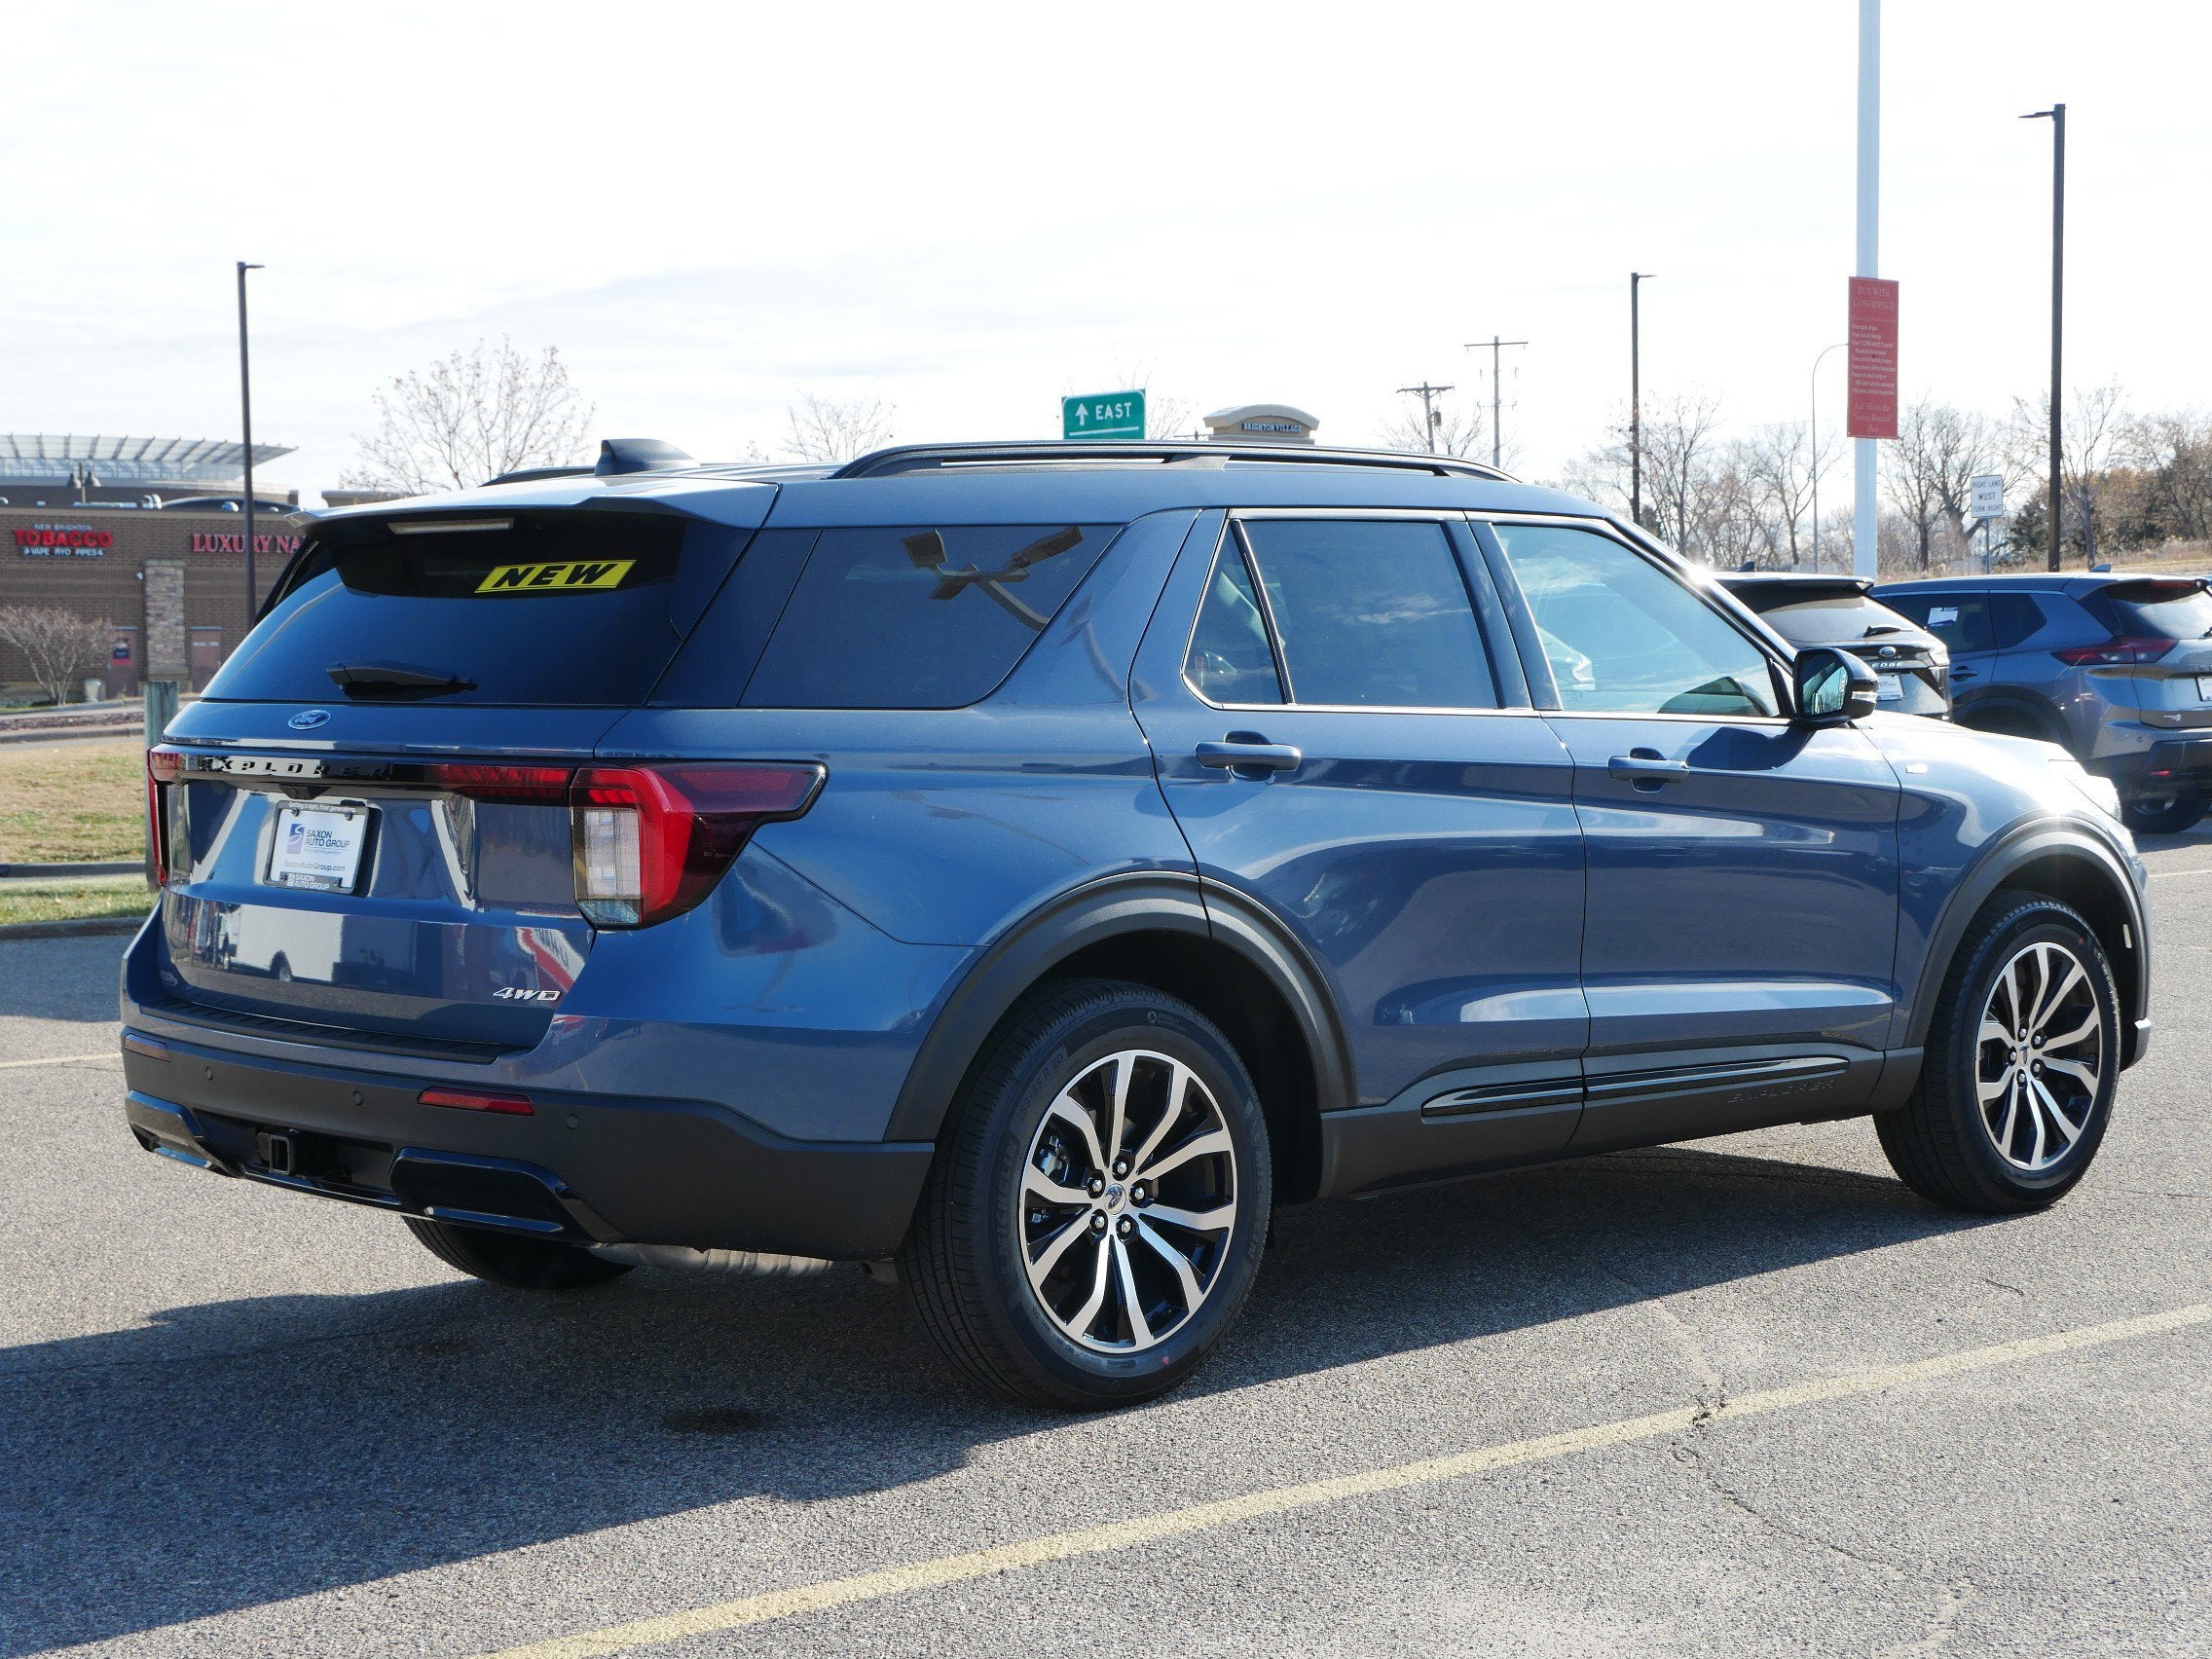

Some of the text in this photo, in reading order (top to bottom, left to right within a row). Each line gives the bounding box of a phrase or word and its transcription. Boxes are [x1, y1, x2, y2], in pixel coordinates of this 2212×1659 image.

[1095, 401, 1132, 421] EAST
[1242, 423, 1302, 433] BRIGHTON VILLAGE
[1978, 492, 1996, 500] MUST
[12, 529, 114, 547] TOBACCO
[491, 563, 619, 588] NEW
[291, 711, 326, 725] Ford
[307, 830, 332, 838] SAXON
[305, 838, 350, 848] AUTO GROUP
[283, 860, 346, 871] SaxonAutoGroup.com
[493, 987, 561, 1001] 4WD
